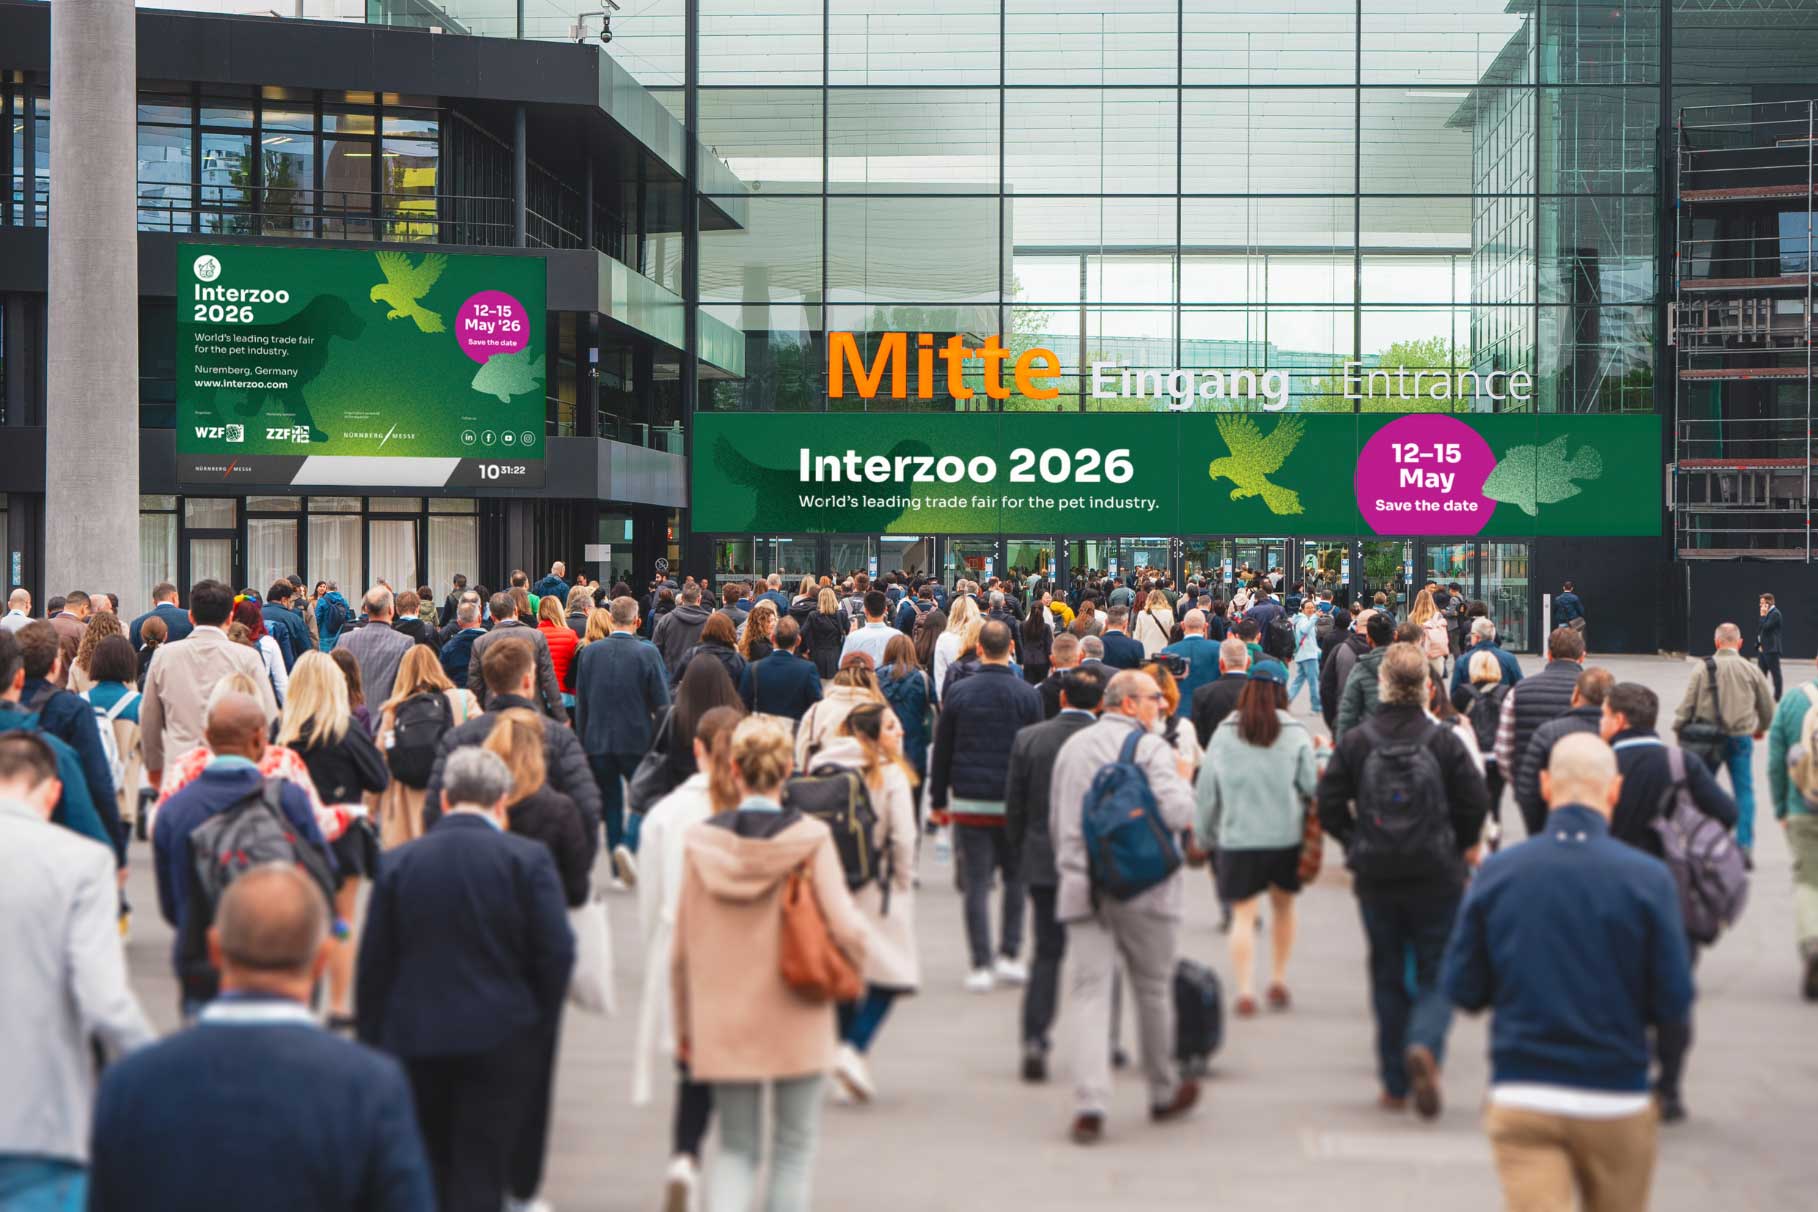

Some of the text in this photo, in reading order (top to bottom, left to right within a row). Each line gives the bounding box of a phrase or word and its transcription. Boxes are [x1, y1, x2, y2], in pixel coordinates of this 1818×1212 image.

[194, 283, 290, 304] Interzoo
[194, 304, 254, 323] 2026
[465, 318, 496, 334] May
[233, 334, 269, 345] leading
[271, 336, 297, 345] trade
[298, 336, 315, 345] fair
[468, 338, 518, 347] Save the date
[194, 345, 289, 358] for the pet industry.
[194, 364, 299, 378] Nuremberg, Germany
[828, 332, 1533, 411] Mitte Eingang Entrance
[194, 379, 289, 389] www.interzoo.com
[194, 426, 225, 439] WZF
[266, 428, 291, 440] ZZF
[478, 464, 526, 479] 10 31:22
[799, 448, 1134, 483] Interzoo 2026
[1399, 468, 1455, 493] May
[862, 494, 922, 512] leading
[924, 495, 968, 510] trade
[970, 495, 998, 509] fair
[1001, 495, 1026, 509] for
[1027, 495, 1057, 510] the
[1058, 497, 1087, 512] pet
[1089, 495, 1160, 512] industry.
[1375, 500, 1478, 512] Save the date
